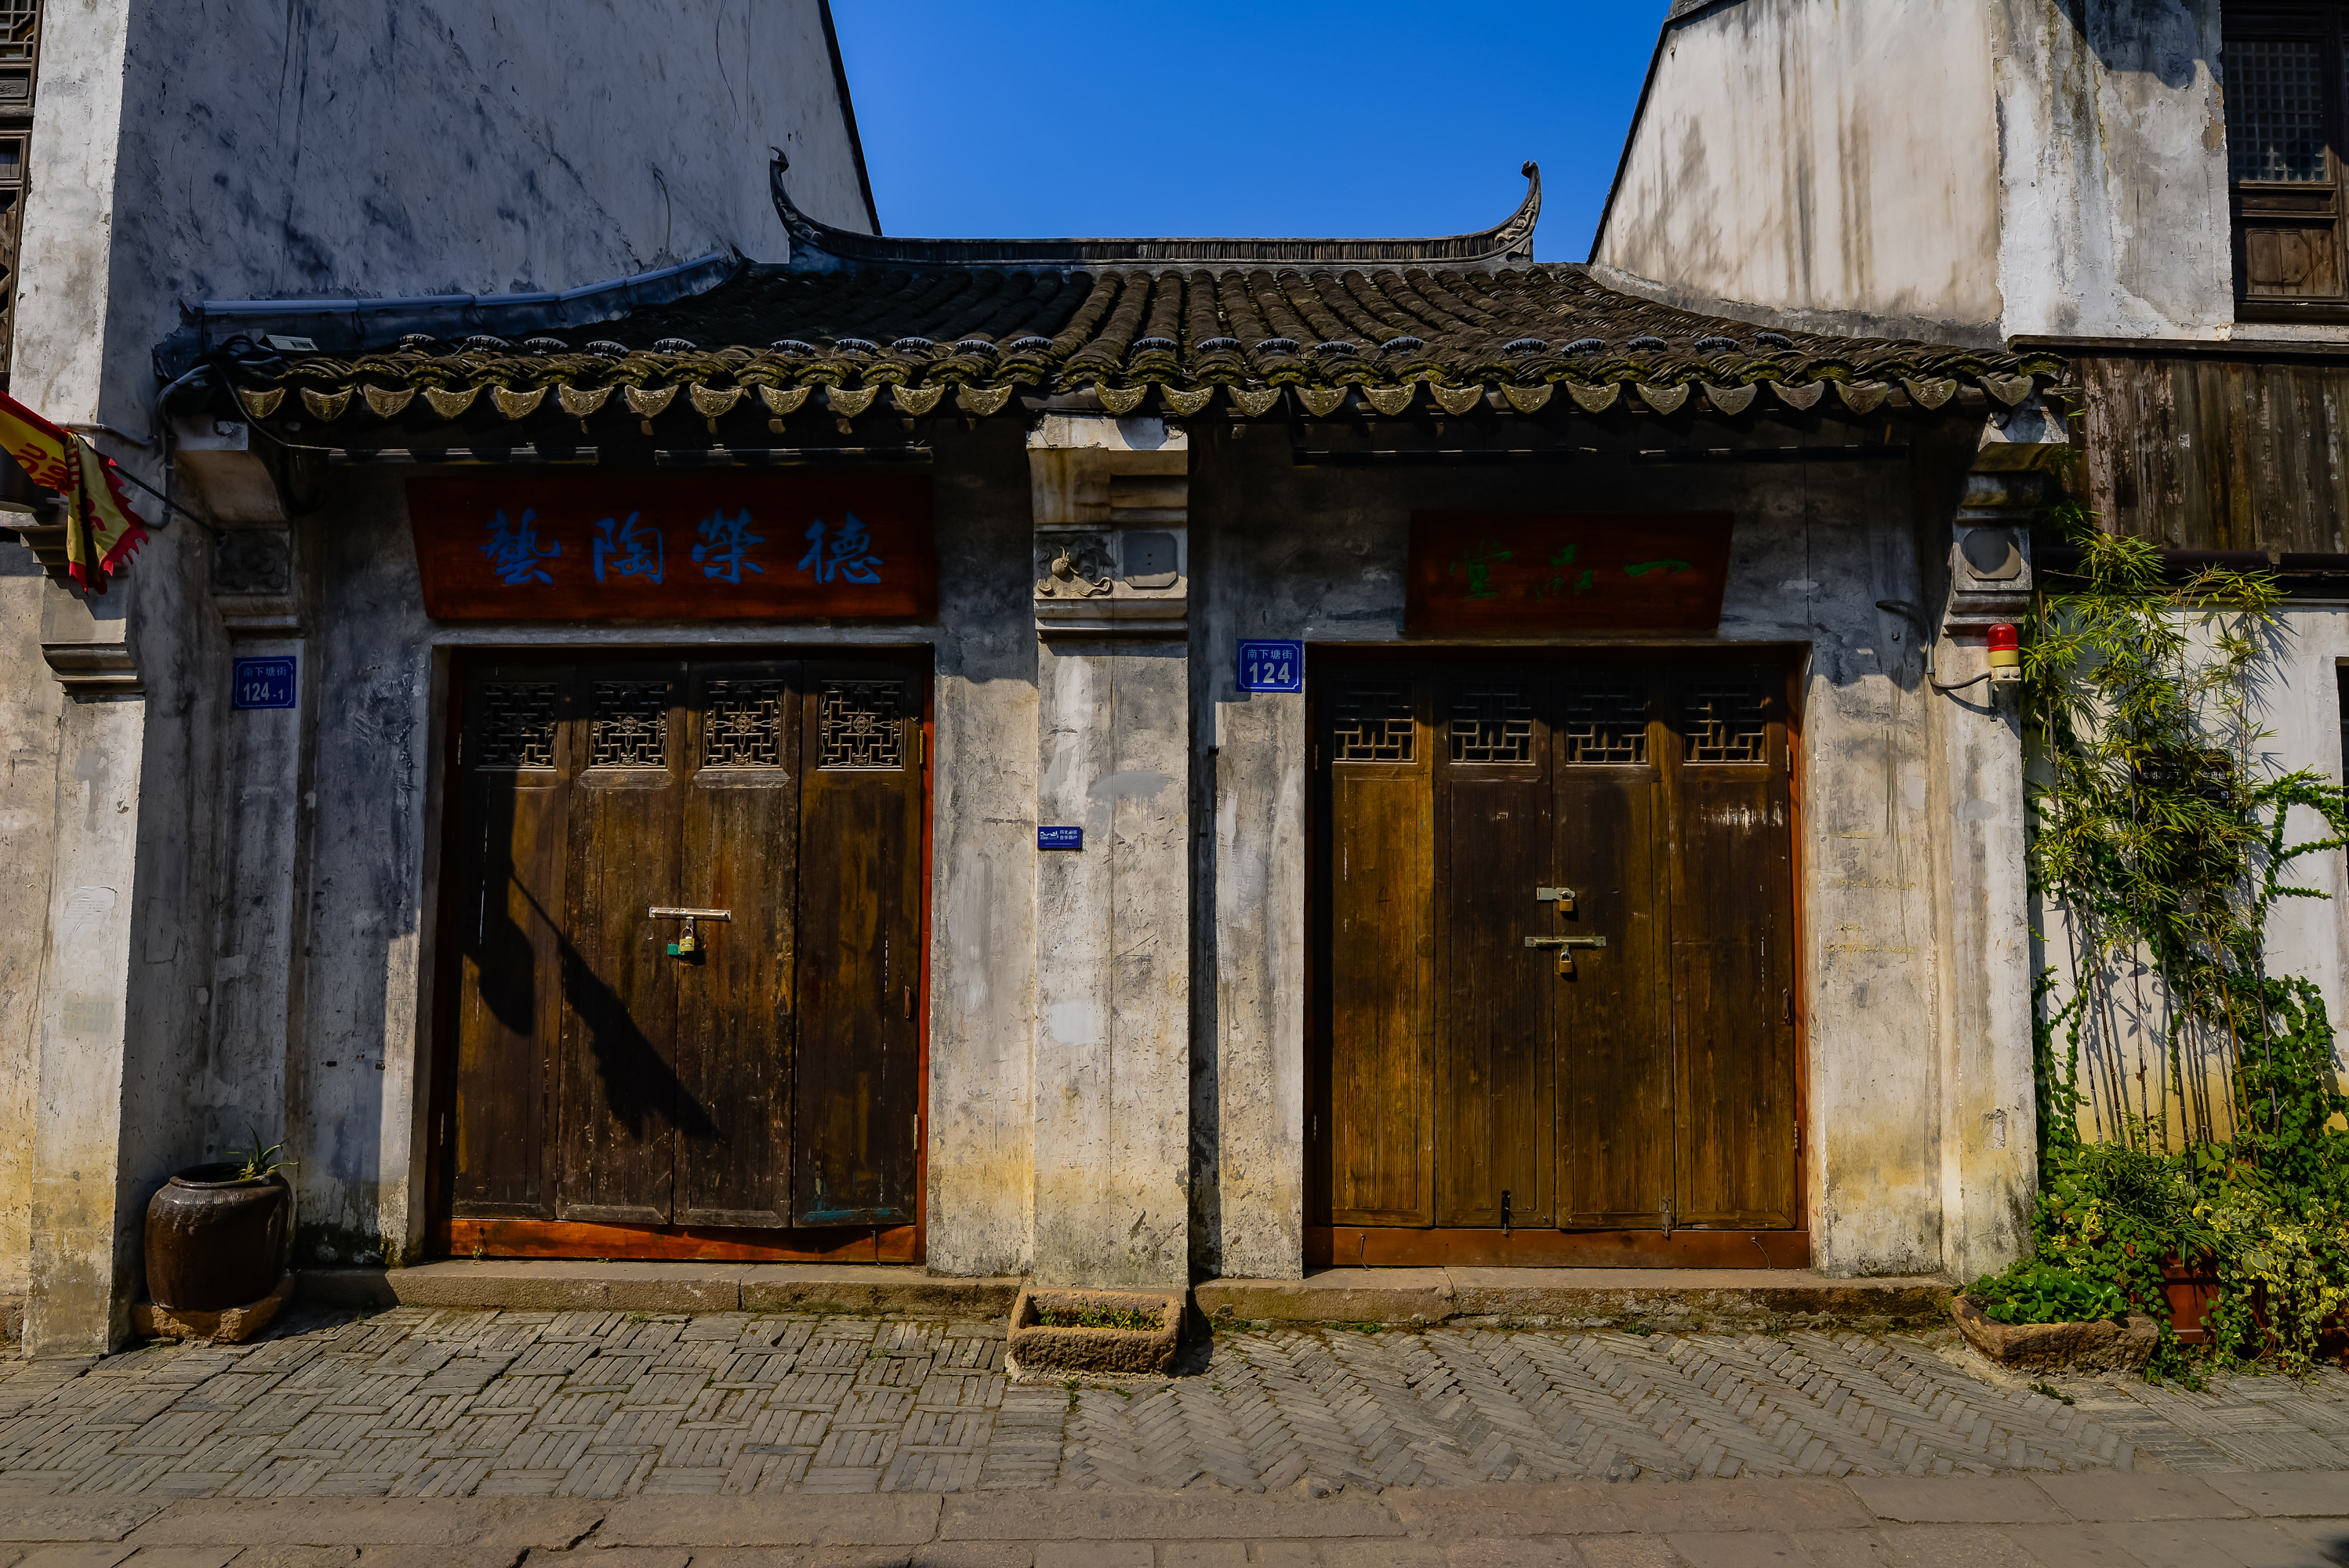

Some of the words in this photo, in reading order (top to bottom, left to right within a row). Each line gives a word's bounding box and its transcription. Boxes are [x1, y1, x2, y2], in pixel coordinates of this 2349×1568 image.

[1247, 649, 1293, 660] 南下塘街
[243, 666, 287, 677] 南下塘街
[1249, 662, 1291, 684] 124
